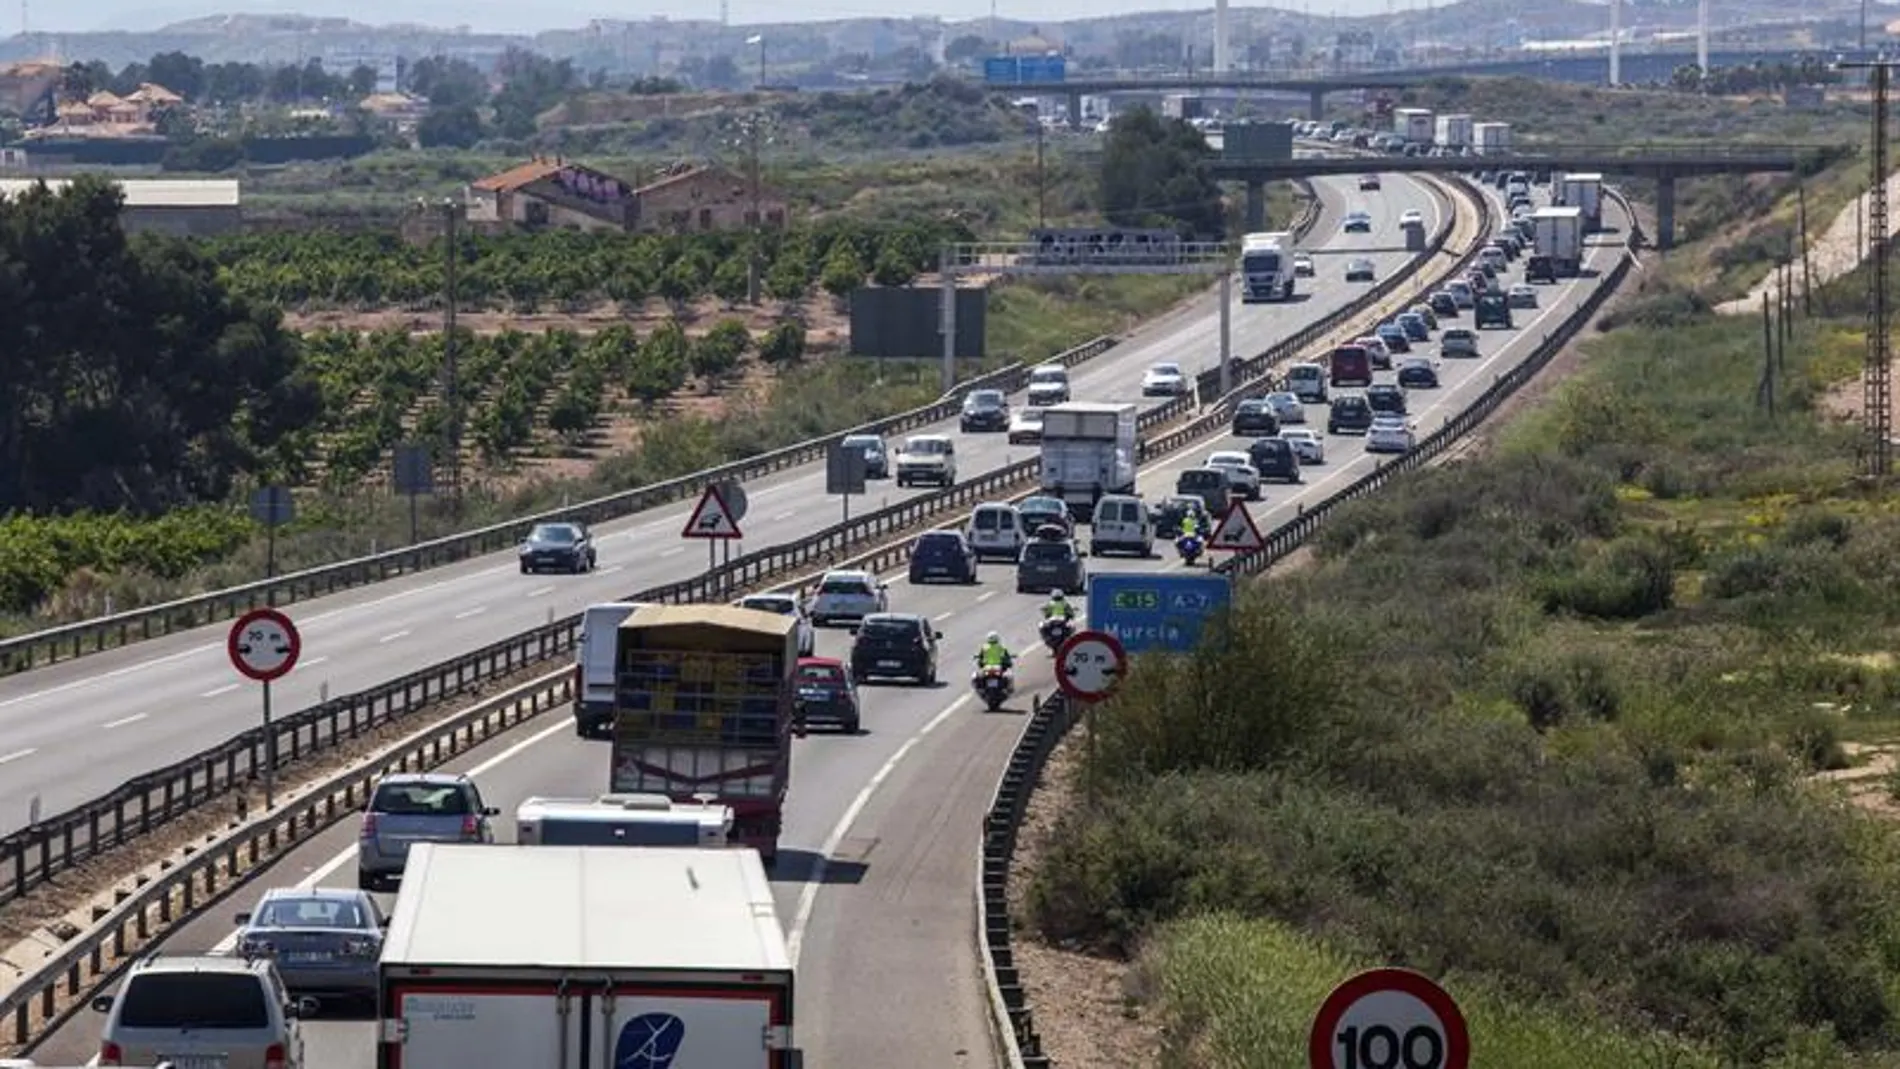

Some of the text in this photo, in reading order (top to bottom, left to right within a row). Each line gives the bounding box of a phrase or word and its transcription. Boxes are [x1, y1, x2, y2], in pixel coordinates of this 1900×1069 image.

[1115, 592, 1208, 609] E-15 A-7
[248, 630, 264, 642] 70
[1103, 621, 1179, 639] Murcia
[1073, 651, 1106, 664] 70 m
[1337, 1025, 1443, 1069] 100
